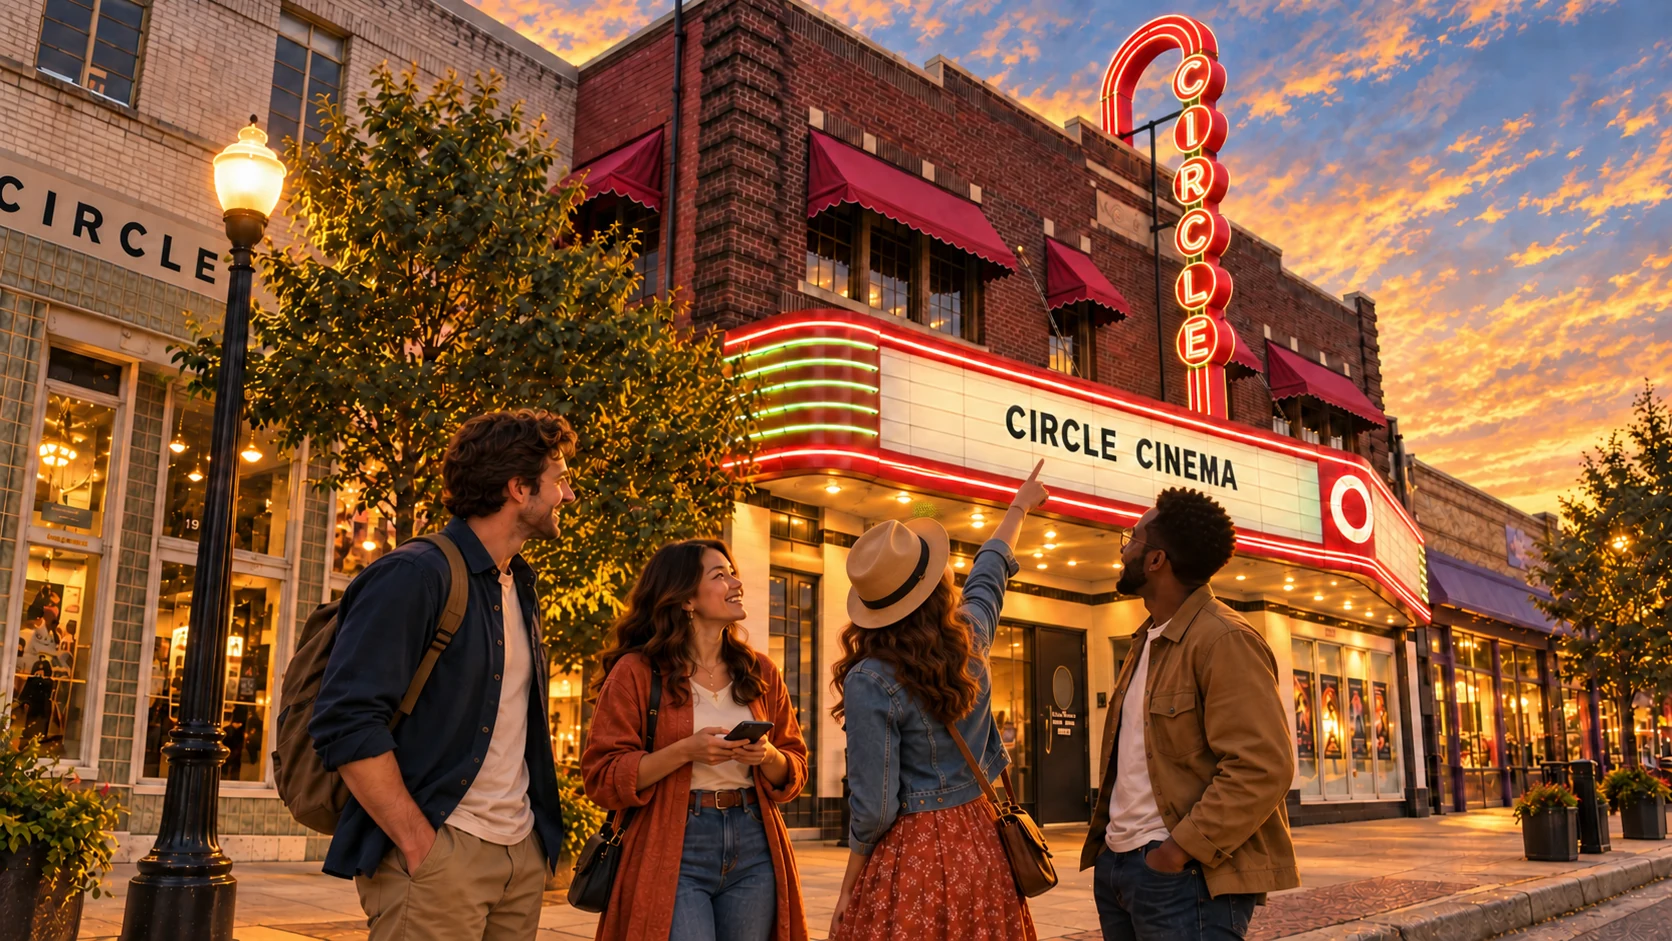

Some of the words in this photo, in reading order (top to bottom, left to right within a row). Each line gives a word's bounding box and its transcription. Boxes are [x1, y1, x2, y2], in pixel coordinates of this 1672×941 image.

[0, 175, 219, 285] CIRCLE
[1176, 58, 1210, 361] CIRCLE
[1005, 404, 1117, 462] CIRCLE
[1136, 437, 1238, 491] CINEMA
